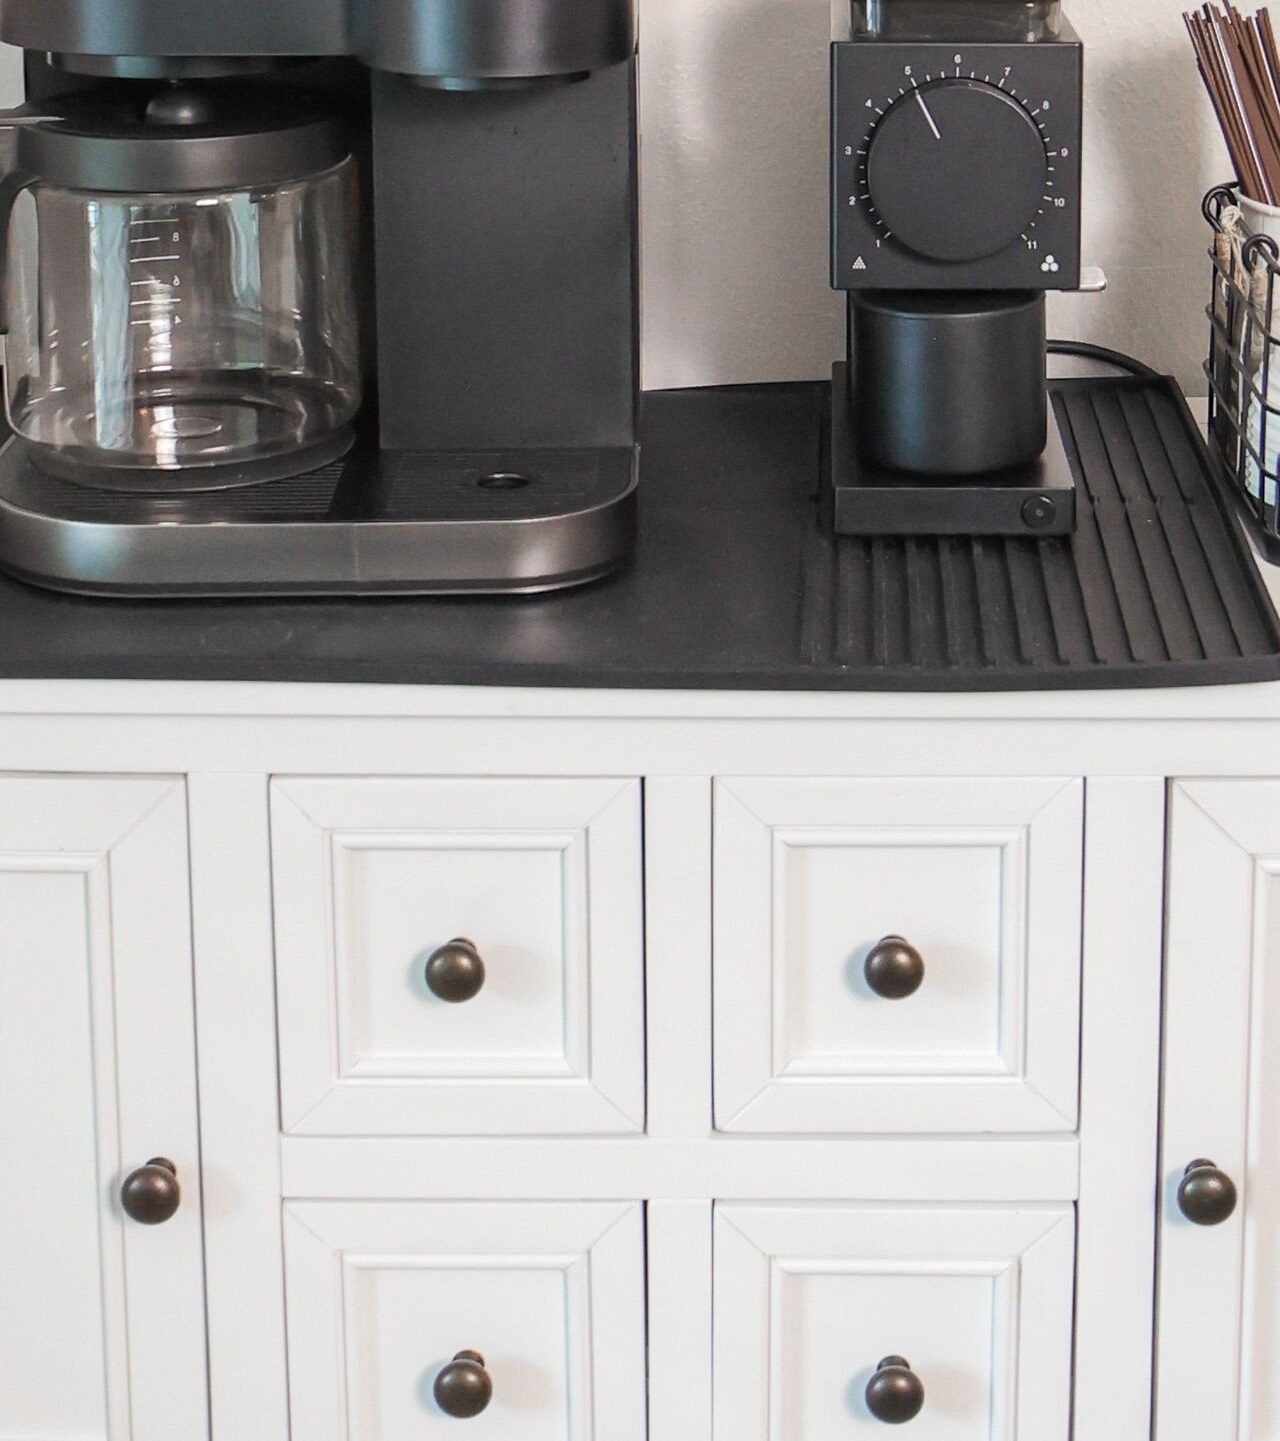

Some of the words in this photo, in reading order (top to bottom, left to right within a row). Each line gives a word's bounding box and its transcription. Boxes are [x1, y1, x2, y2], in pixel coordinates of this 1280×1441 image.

[953, 53, 963, 65] 6
[903, 65, 913, 76] 5
[1003, 66, 1012, 77] 7
[864, 98, 873, 108] 4
[1041, 99, 1051, 111] 8
[844, 145, 853, 156] 3
[1060, 147, 1069, 158] 9
[848, 195, 857, 206] 2
[1053, 197, 1066, 208] 10
[875, 239, 881, 249] 1
[1026, 240, 1038, 251] 11
